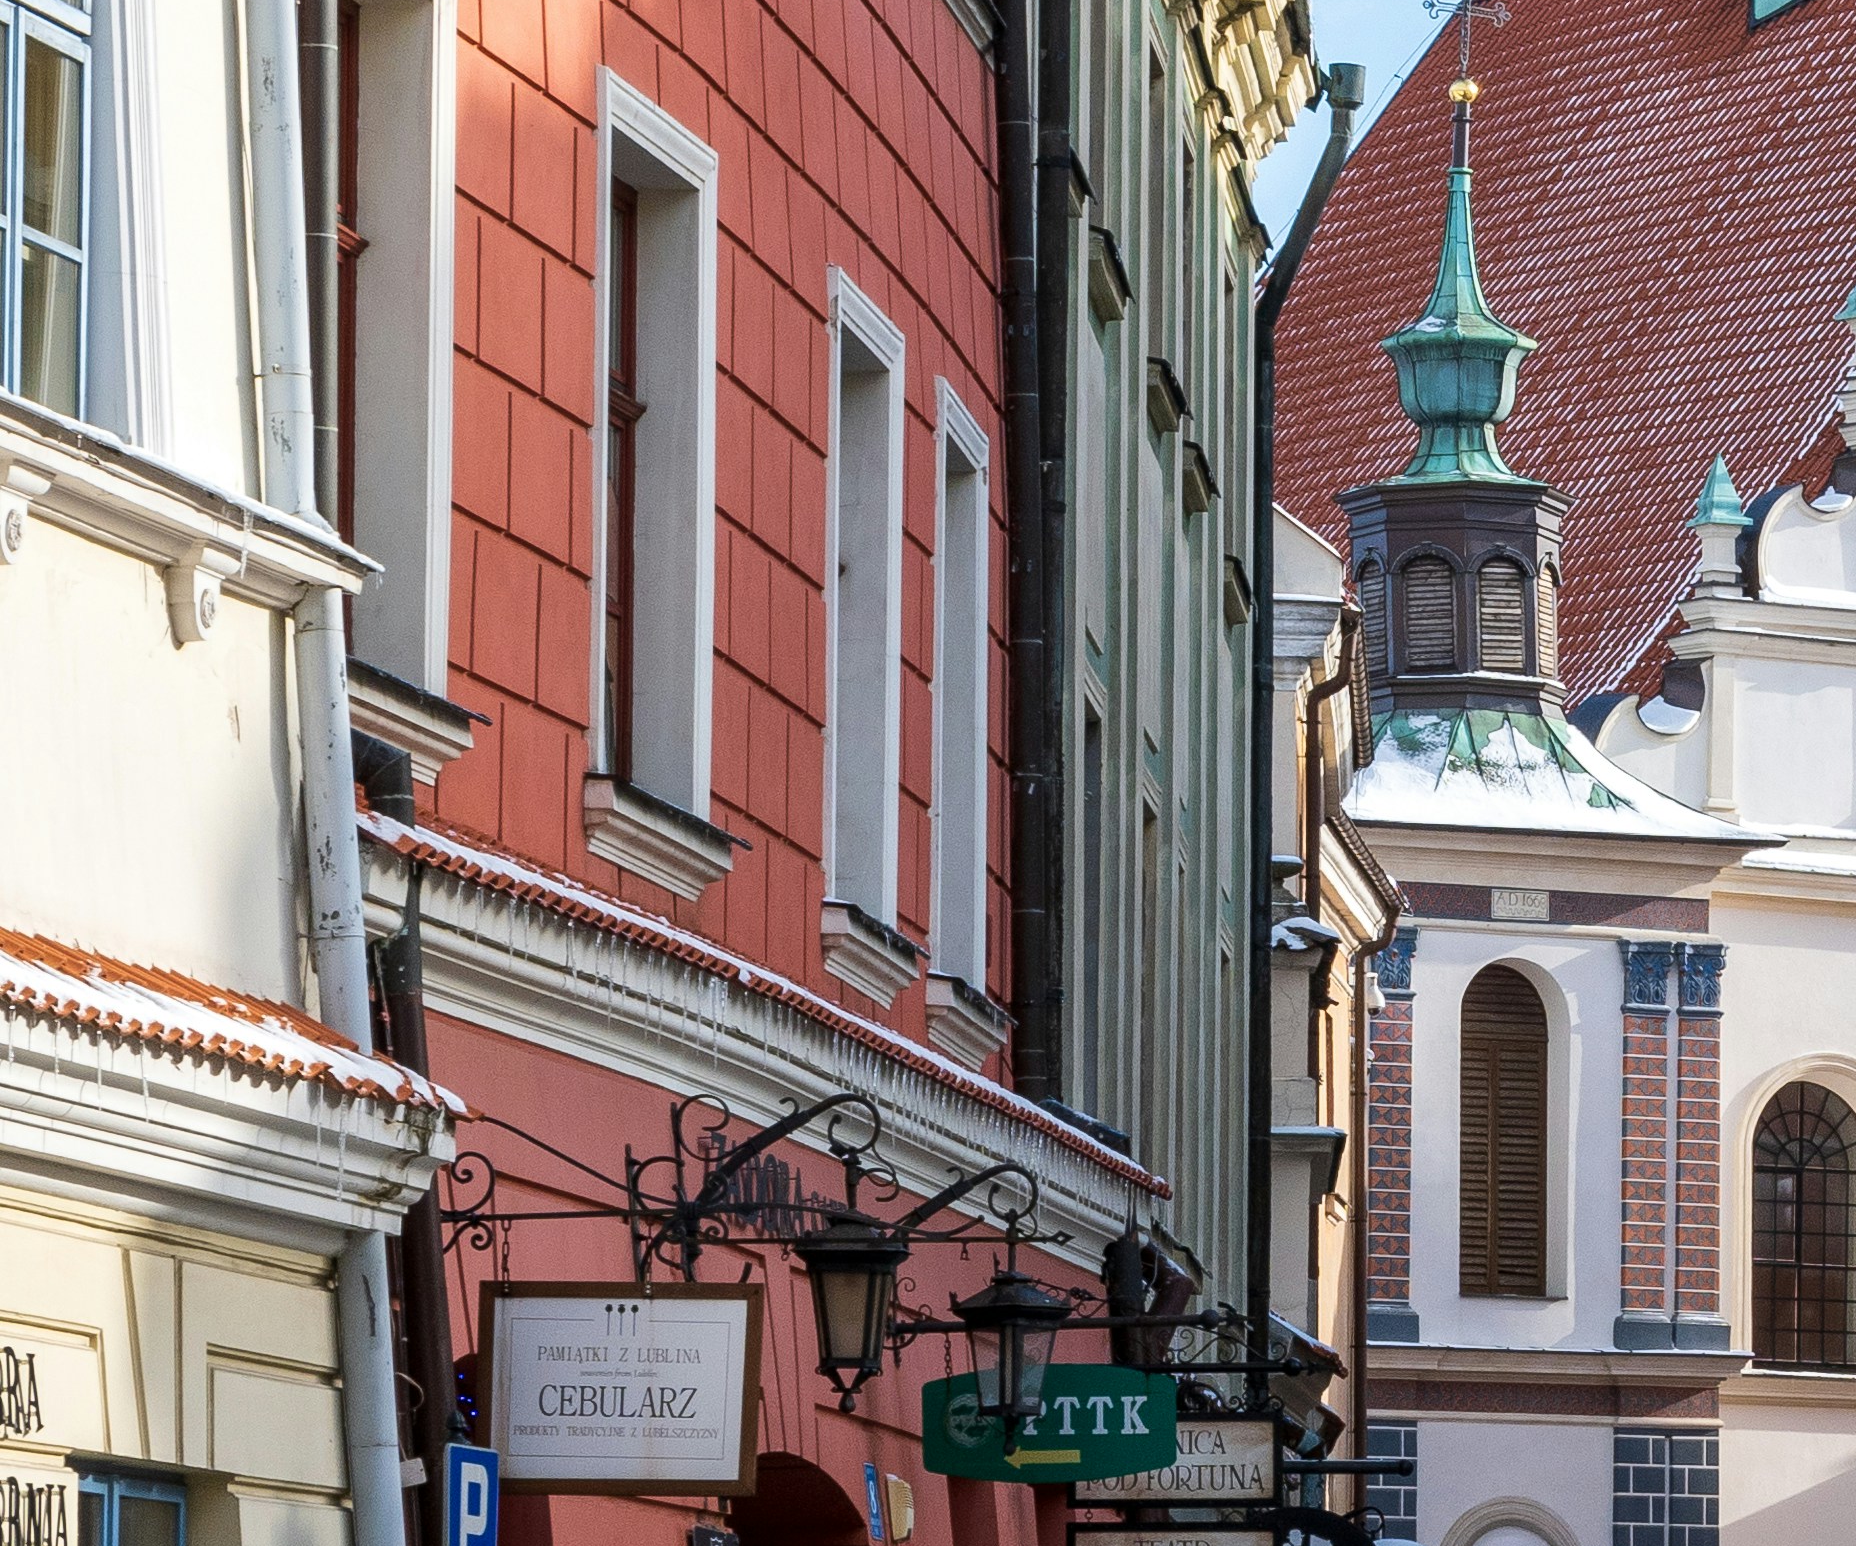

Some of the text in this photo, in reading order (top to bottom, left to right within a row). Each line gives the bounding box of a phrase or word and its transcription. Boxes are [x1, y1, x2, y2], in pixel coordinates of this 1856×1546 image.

[537, 1345, 701, 1365] PAMIĄTKI Z LUBLINA
[538, 1384, 698, 1420] CEBULARZ
[1022, 1395, 1150, 1436] PTTK
[513, 1425, 560, 1438] PRODUKTY
[567, 1425, 626, 1439] TRADYCYJNE
[631, 1428, 637, 1438] Z
[1176, 1429, 1227, 1456] NICA
[868, 1481, 877, 1514] 8
